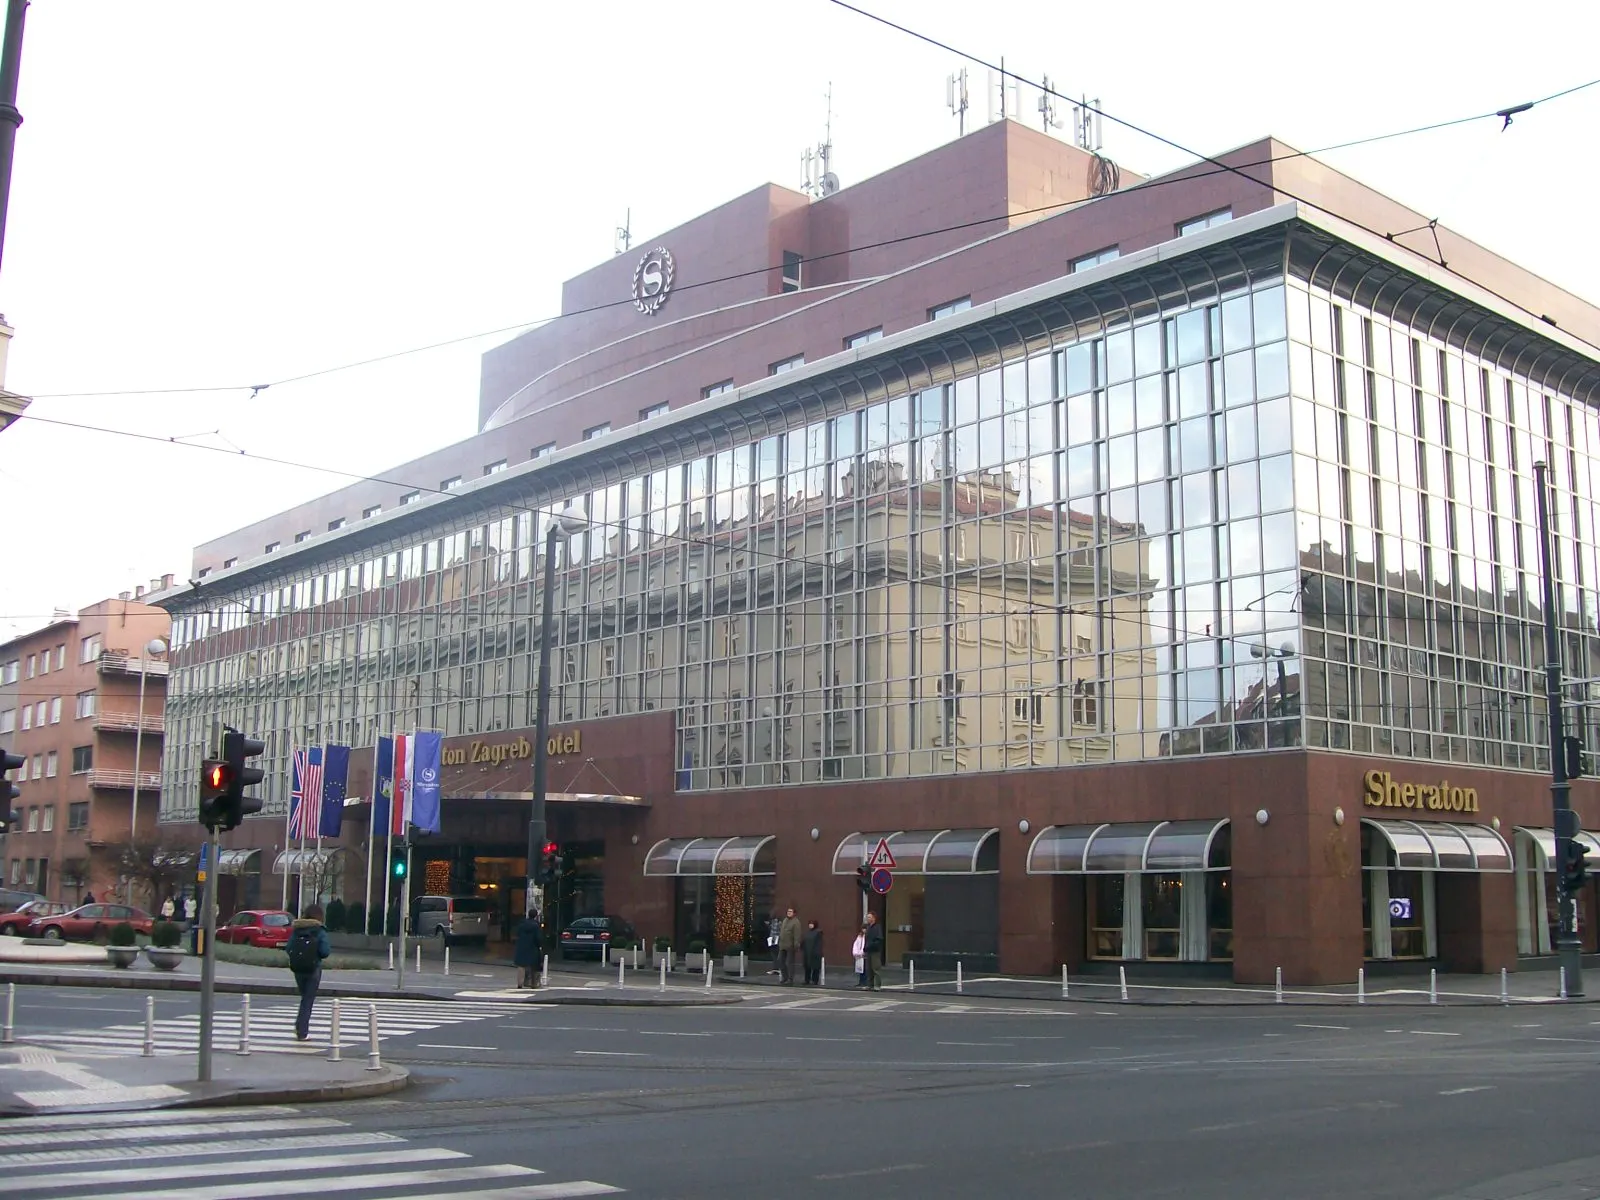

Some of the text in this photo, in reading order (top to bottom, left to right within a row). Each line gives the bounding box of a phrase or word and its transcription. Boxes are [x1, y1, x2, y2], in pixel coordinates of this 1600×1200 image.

[642, 257, 663, 298] S
[470, 736, 532, 766] Zagreb
[547, 729, 582, 756] otel
[1363, 769, 1480, 812] Sheraton
